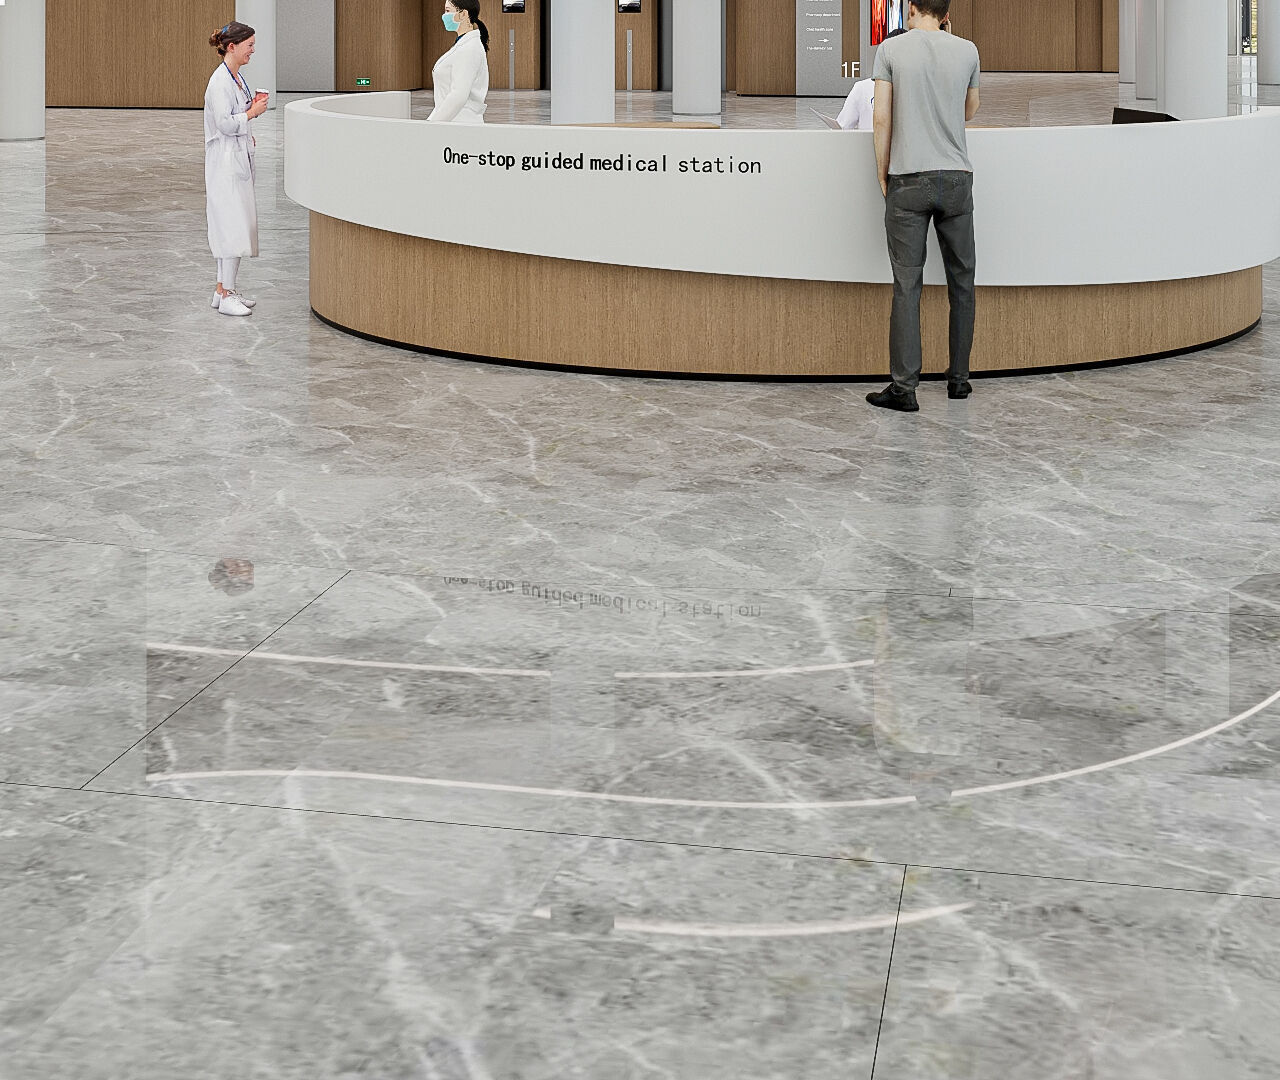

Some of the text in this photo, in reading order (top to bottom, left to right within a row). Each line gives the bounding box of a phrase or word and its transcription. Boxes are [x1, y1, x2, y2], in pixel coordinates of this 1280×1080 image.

[841, 61, 860, 78] 1F
[443, 147, 762, 174] One-stop guided medical station
